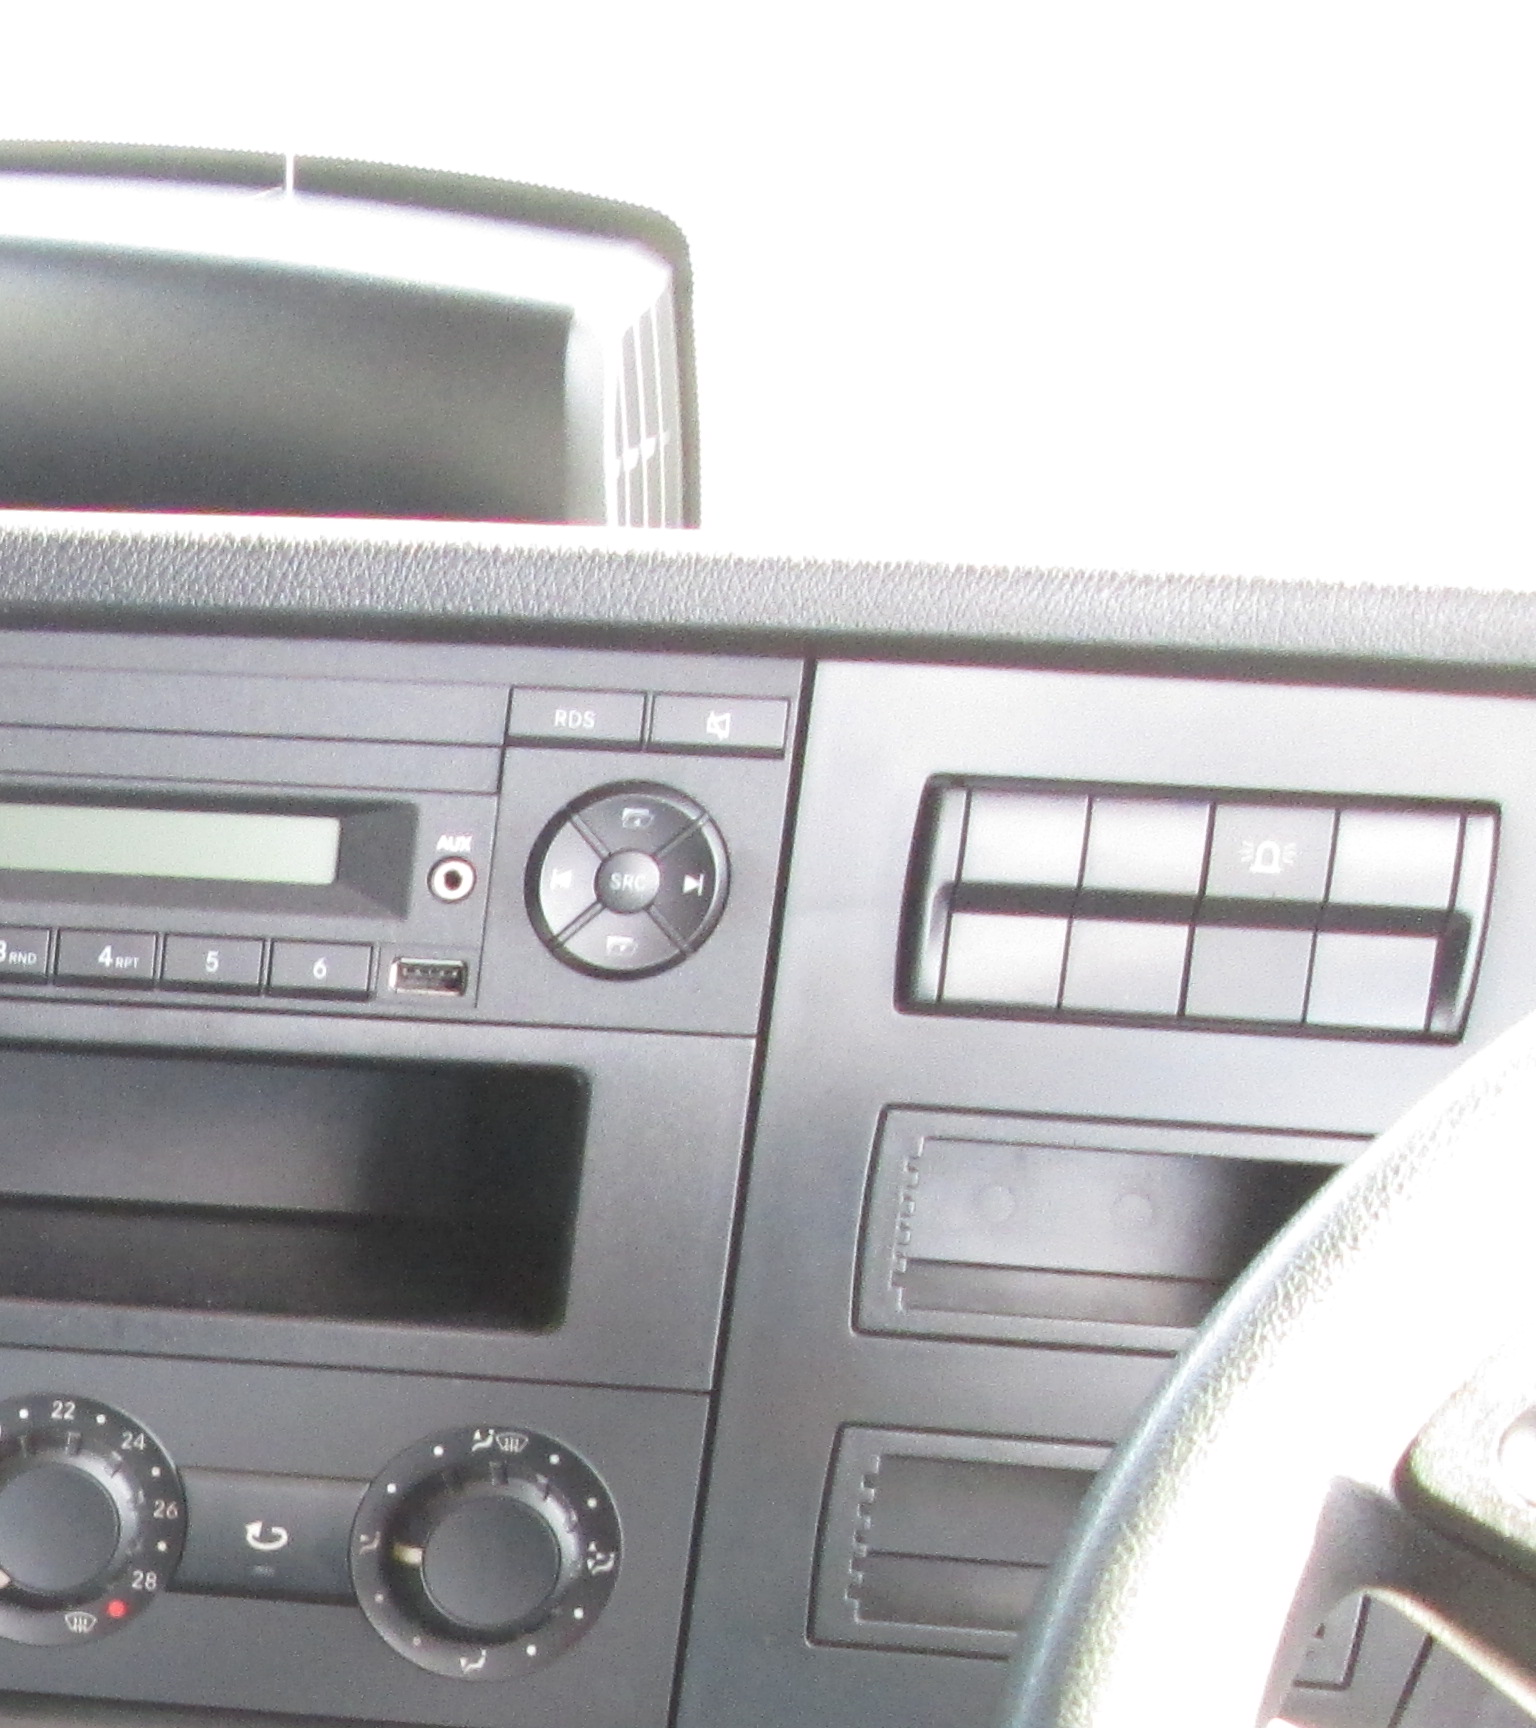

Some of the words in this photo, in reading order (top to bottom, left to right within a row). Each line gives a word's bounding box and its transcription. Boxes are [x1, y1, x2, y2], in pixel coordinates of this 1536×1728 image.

[554, 709, 596, 730] RDS
[436, 834, 473, 853] AUX
[609, 871, 648, 892] SRC
[205, 950, 219, 973] 5
[313, 957, 327, 980] 6
[51, 1401, 76, 1420] 22
[121, 1431, 146, 1451] 24
[153, 1501, 179, 1519] 26
[131, 1571, 157, 1591] 28
